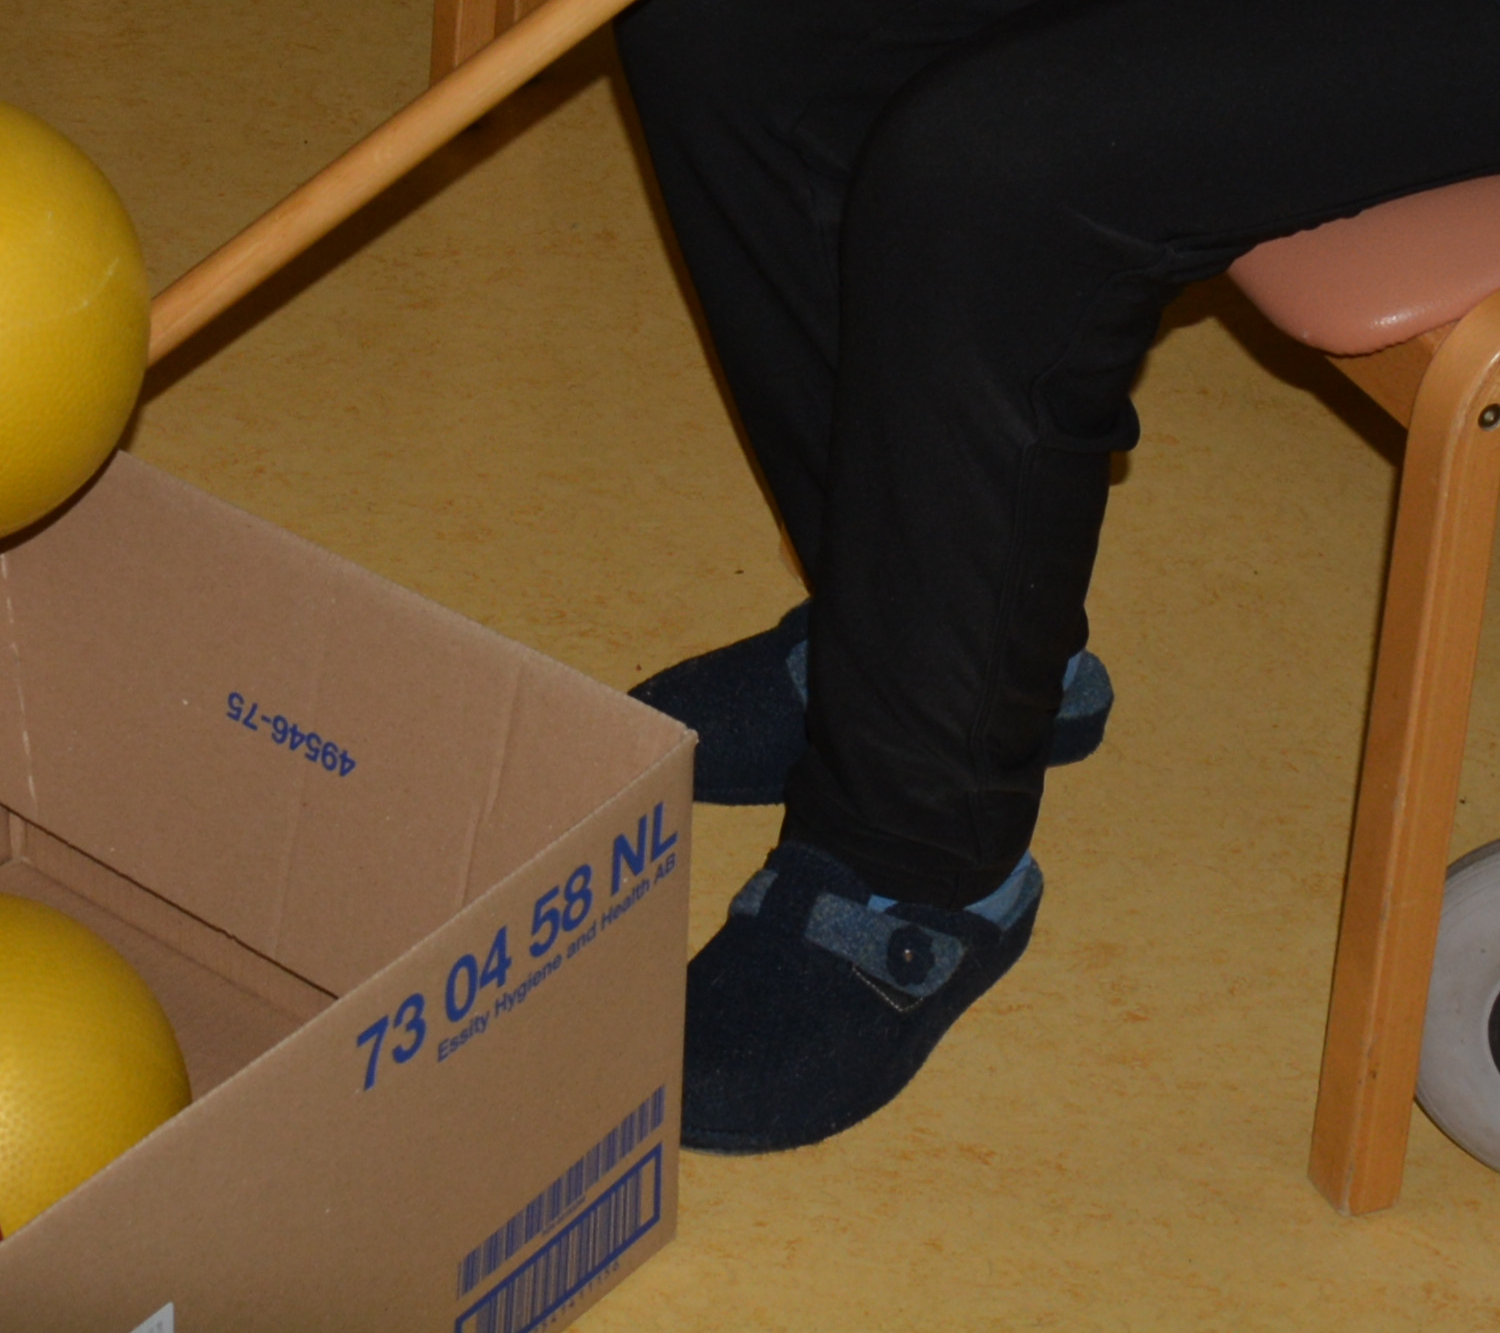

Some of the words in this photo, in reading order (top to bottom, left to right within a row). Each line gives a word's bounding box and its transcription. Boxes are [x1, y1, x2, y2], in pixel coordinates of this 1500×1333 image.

[226, 691, 358, 778] 49546-75
[356, 993, 427, 1093] 73
[444, 925, 514, 1024] 04
[529, 864, 593, 958] 58
[609, 800, 679, 896] NL
[436, 1009, 492, 1064] Essity
[494, 952, 564, 1020] Hygiene
[565, 920, 598, 959] and
[600, 878, 652, 933] Health
[652, 852, 678, 886] AB
